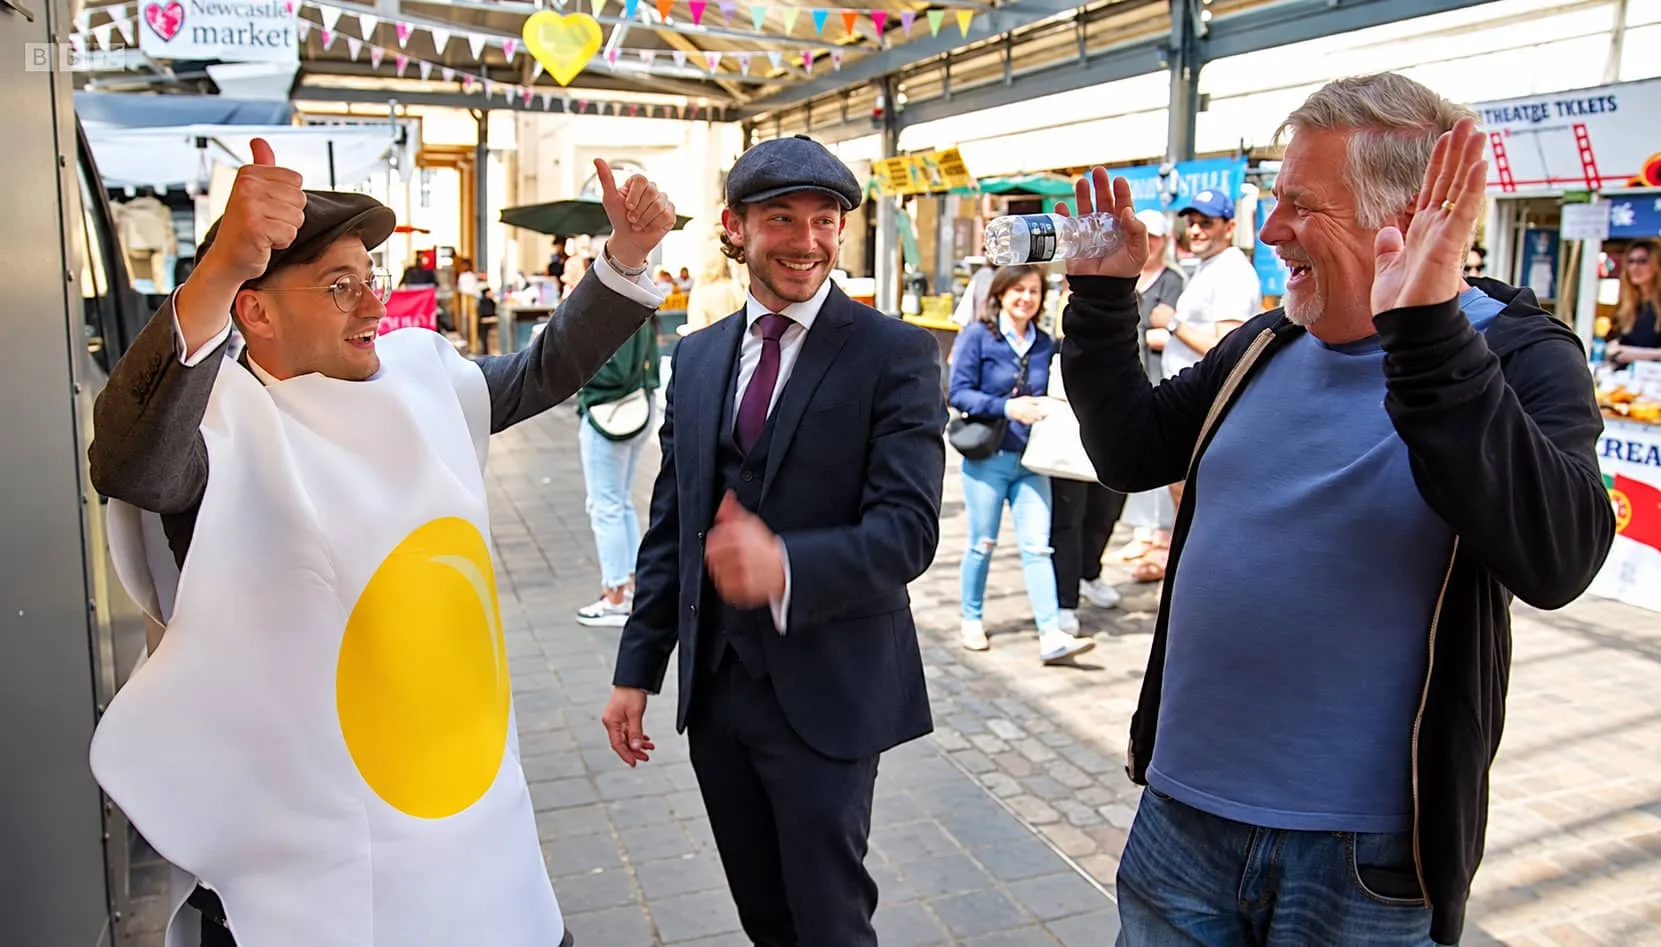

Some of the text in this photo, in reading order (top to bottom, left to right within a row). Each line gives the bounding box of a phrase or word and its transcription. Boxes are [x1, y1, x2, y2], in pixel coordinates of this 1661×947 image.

[192, 0, 287, 17] Newcastle
[192, 22, 291, 47] market
[1599, 437, 1661, 467] REA
